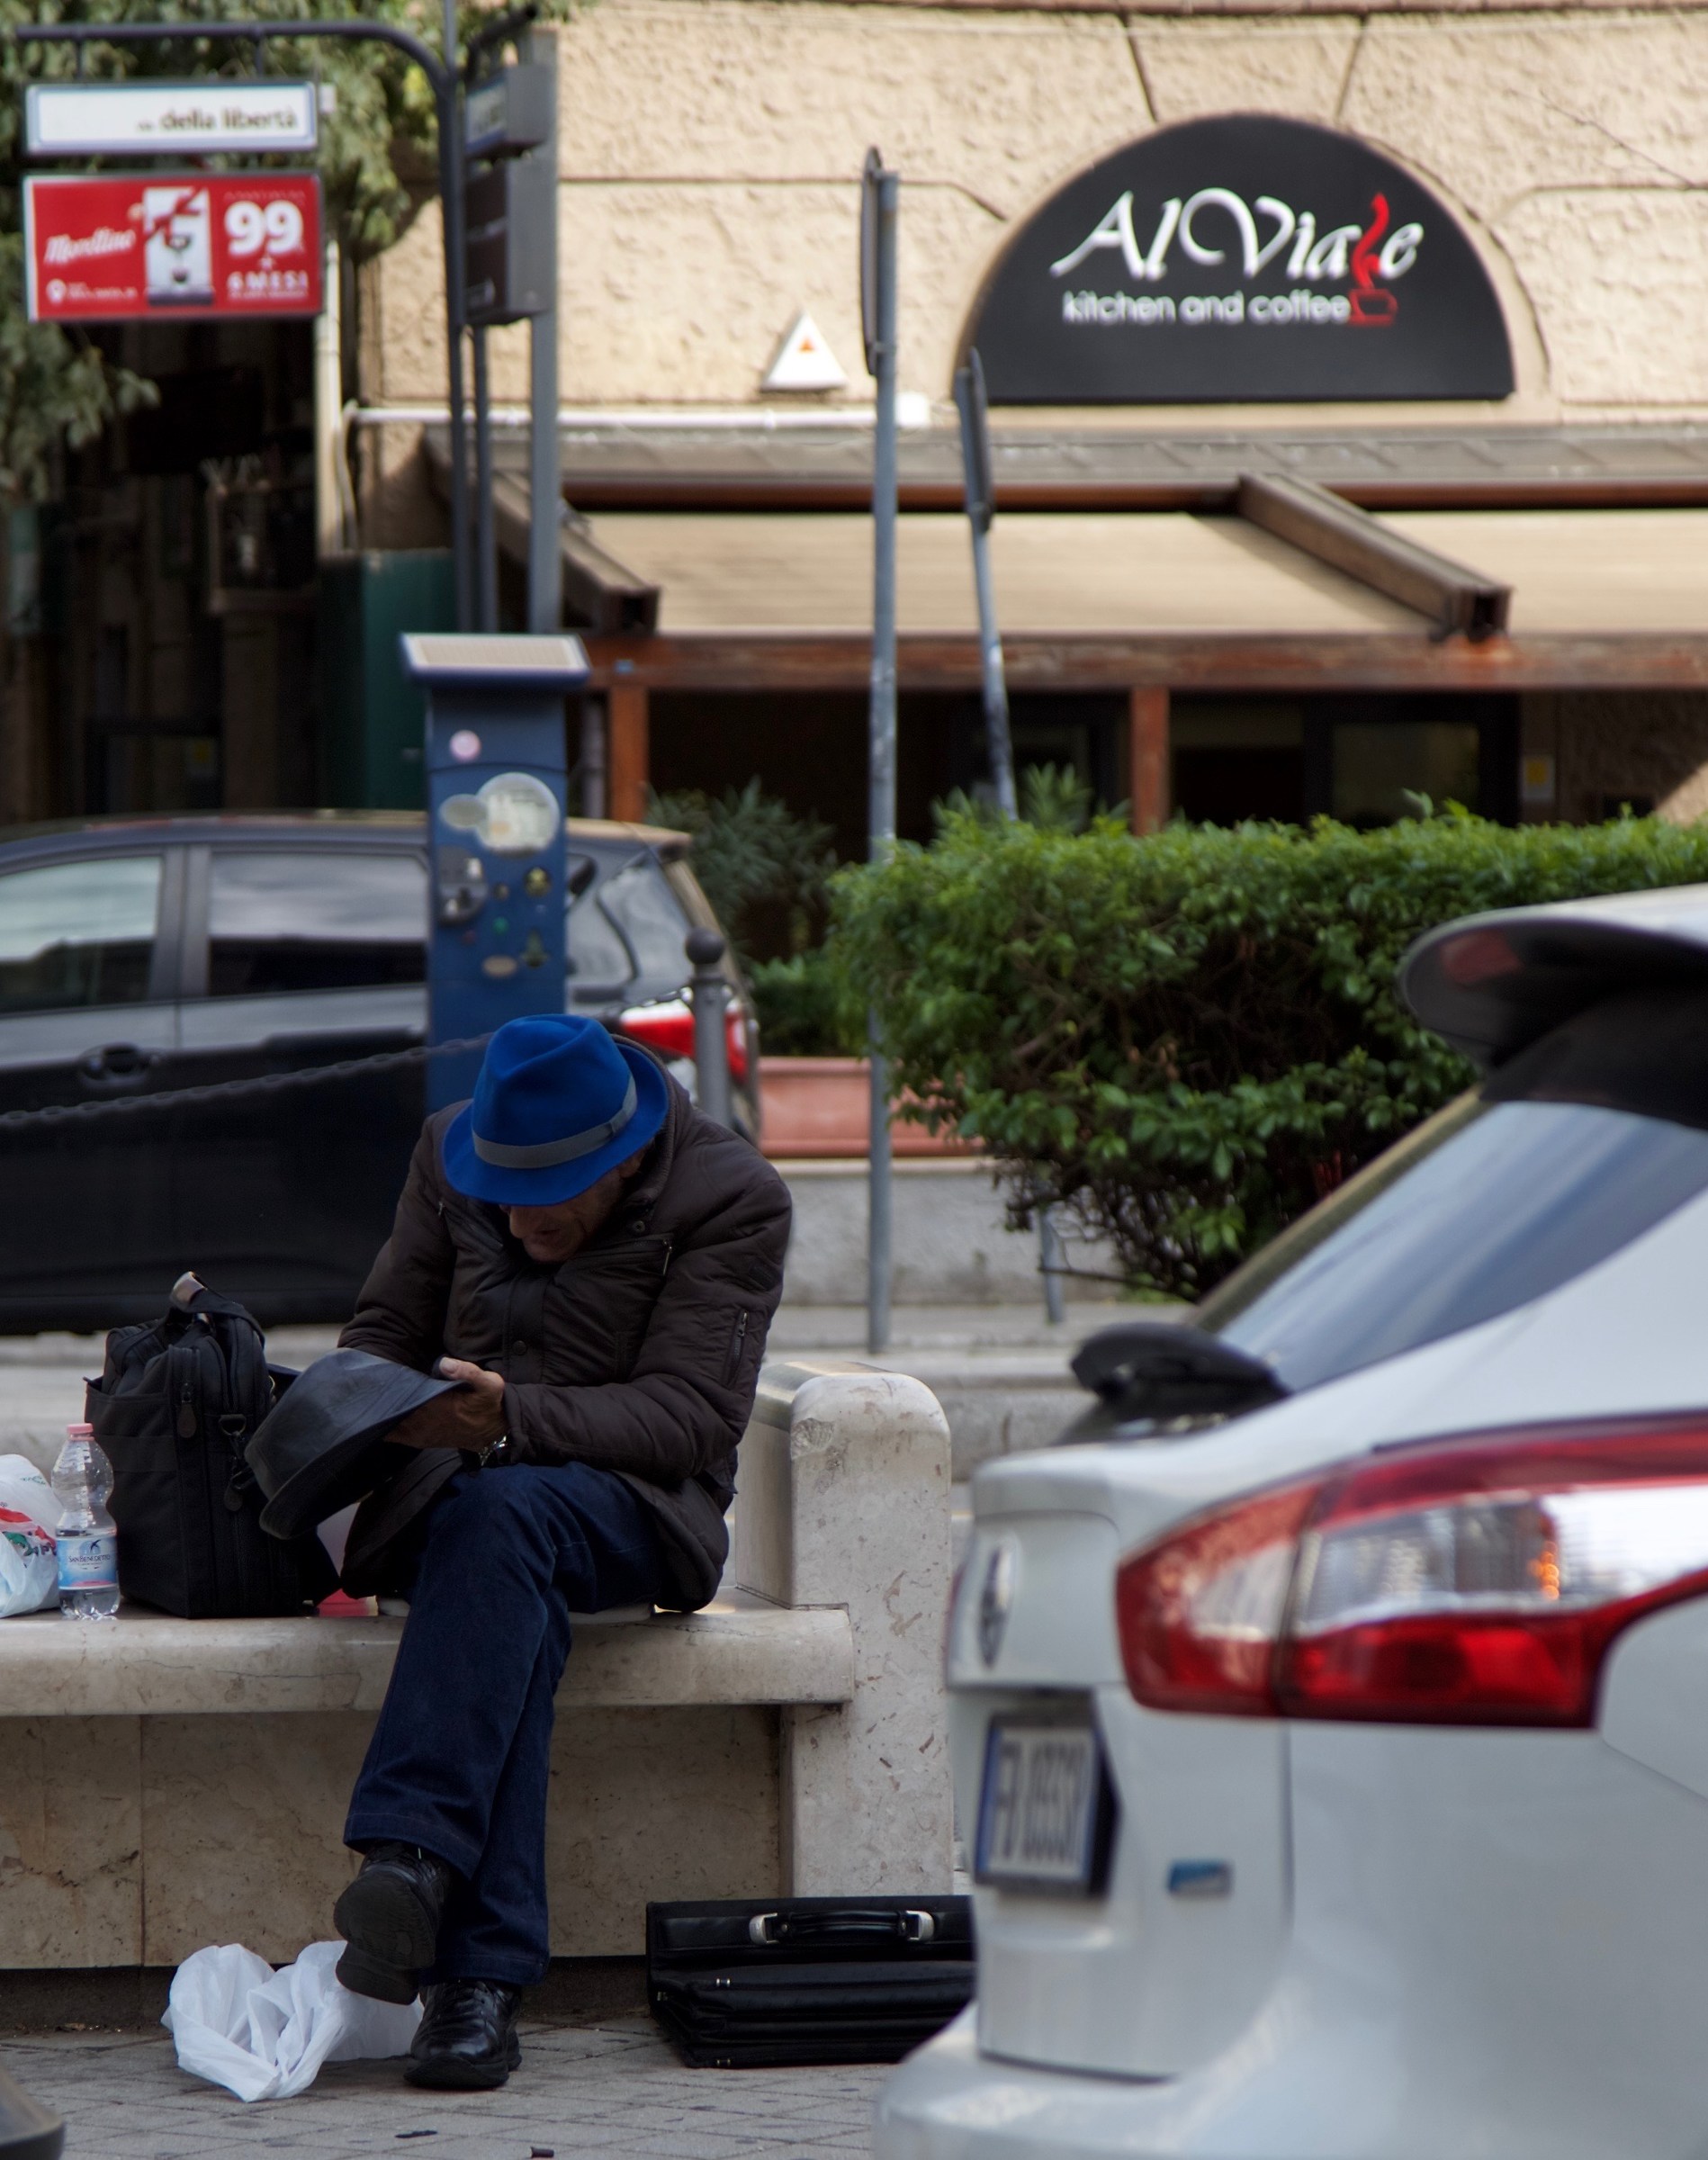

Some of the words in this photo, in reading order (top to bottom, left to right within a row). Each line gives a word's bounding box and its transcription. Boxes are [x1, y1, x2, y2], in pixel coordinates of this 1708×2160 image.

[163, 107, 216, 130] della
[221, 105, 298, 129] libertà
[224, 200, 304, 256] 99
[1049, 189, 1182, 282] Al
[1177, 186, 1425, 290] Viale
[1062, 289, 1176, 325] kitchen
[1178, 289, 1245, 325] and
[1247, 288, 1352, 325] coffee
